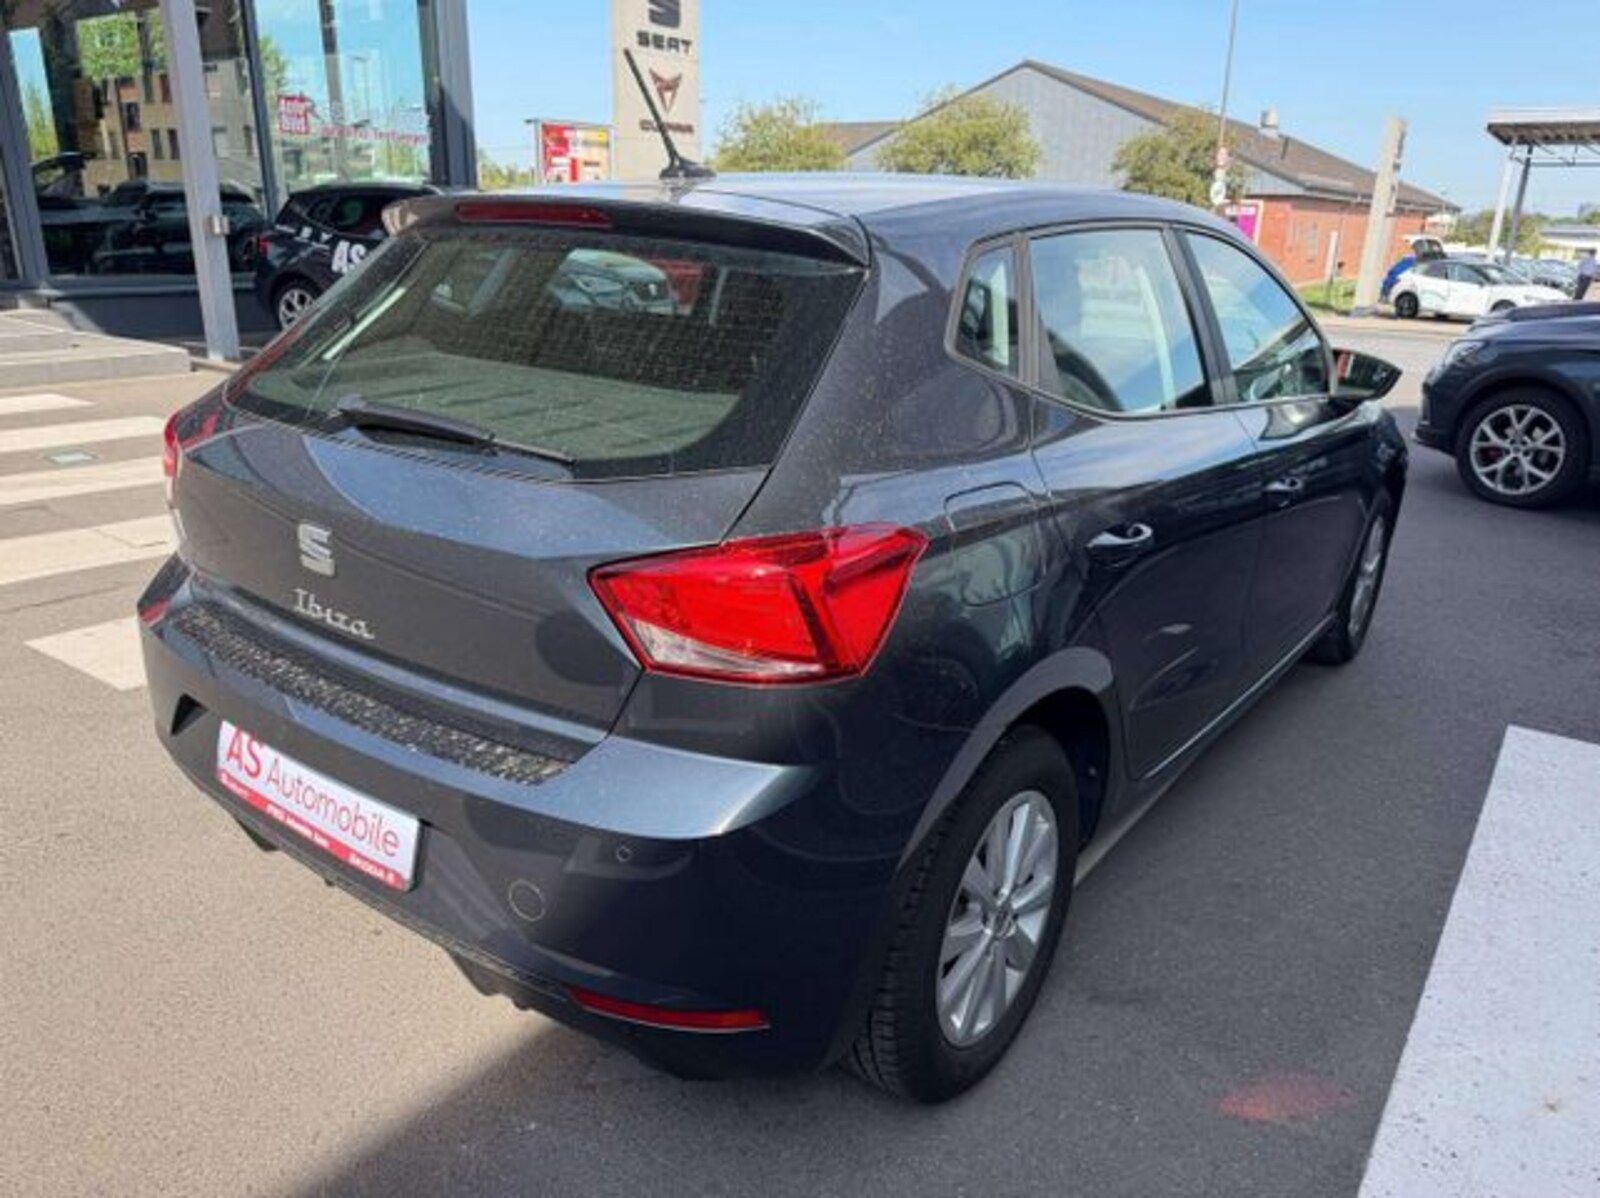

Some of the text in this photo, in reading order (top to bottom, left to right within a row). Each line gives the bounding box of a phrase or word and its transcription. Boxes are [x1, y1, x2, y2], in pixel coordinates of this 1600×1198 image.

[636, 30, 692, 54] SEAT
[291, 587, 376, 640] Ibiza
[226, 724, 267, 780] AS
[265, 756, 401, 858] Automobile
